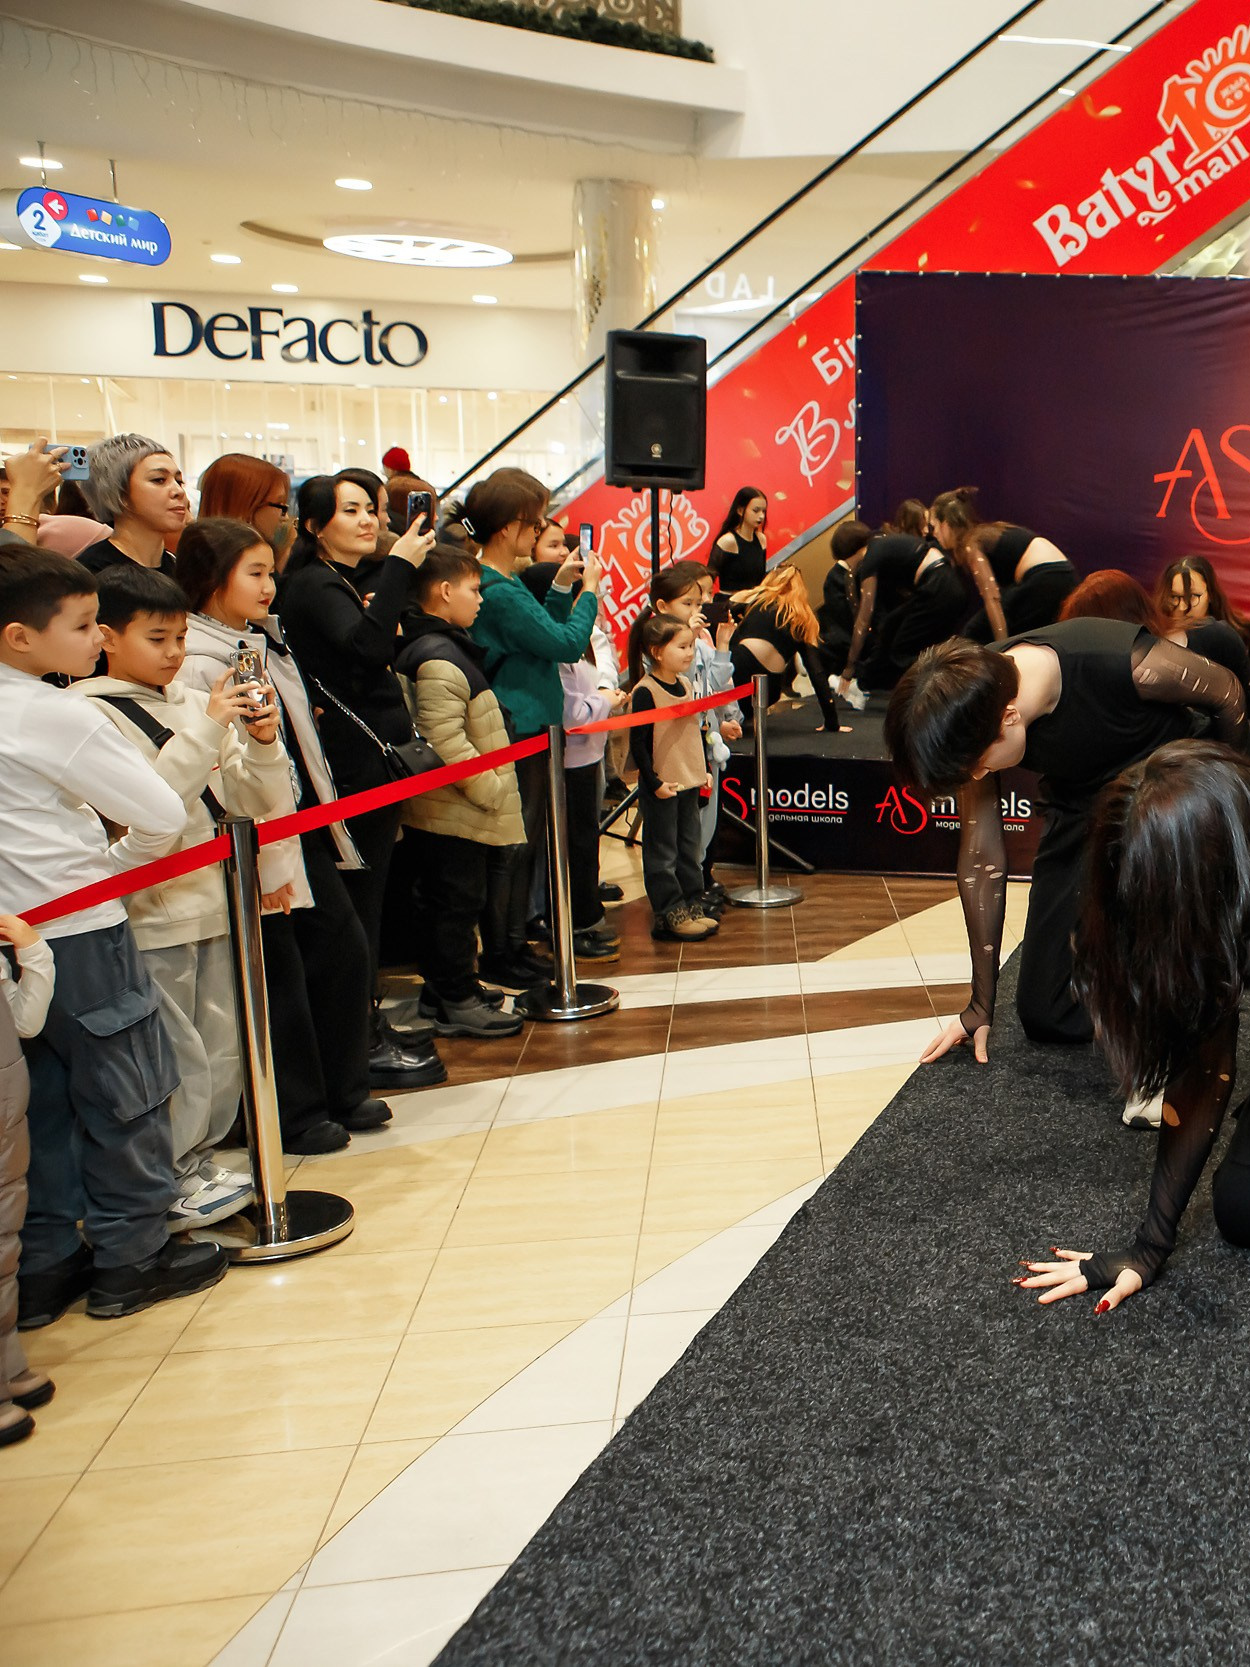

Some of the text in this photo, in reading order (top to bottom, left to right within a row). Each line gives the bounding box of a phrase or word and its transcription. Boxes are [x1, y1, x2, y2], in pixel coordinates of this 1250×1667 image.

[1173, 135, 1250, 203] mall
[32, 209, 46, 231] 2
[1032, 136, 1182, 268] Batyr
[70, 223, 158, 257] Детский мир
[151, 301, 428, 368] DeFacto
[768, 813, 843, 824] дельная школа
[875, 785, 927, 834] AS
